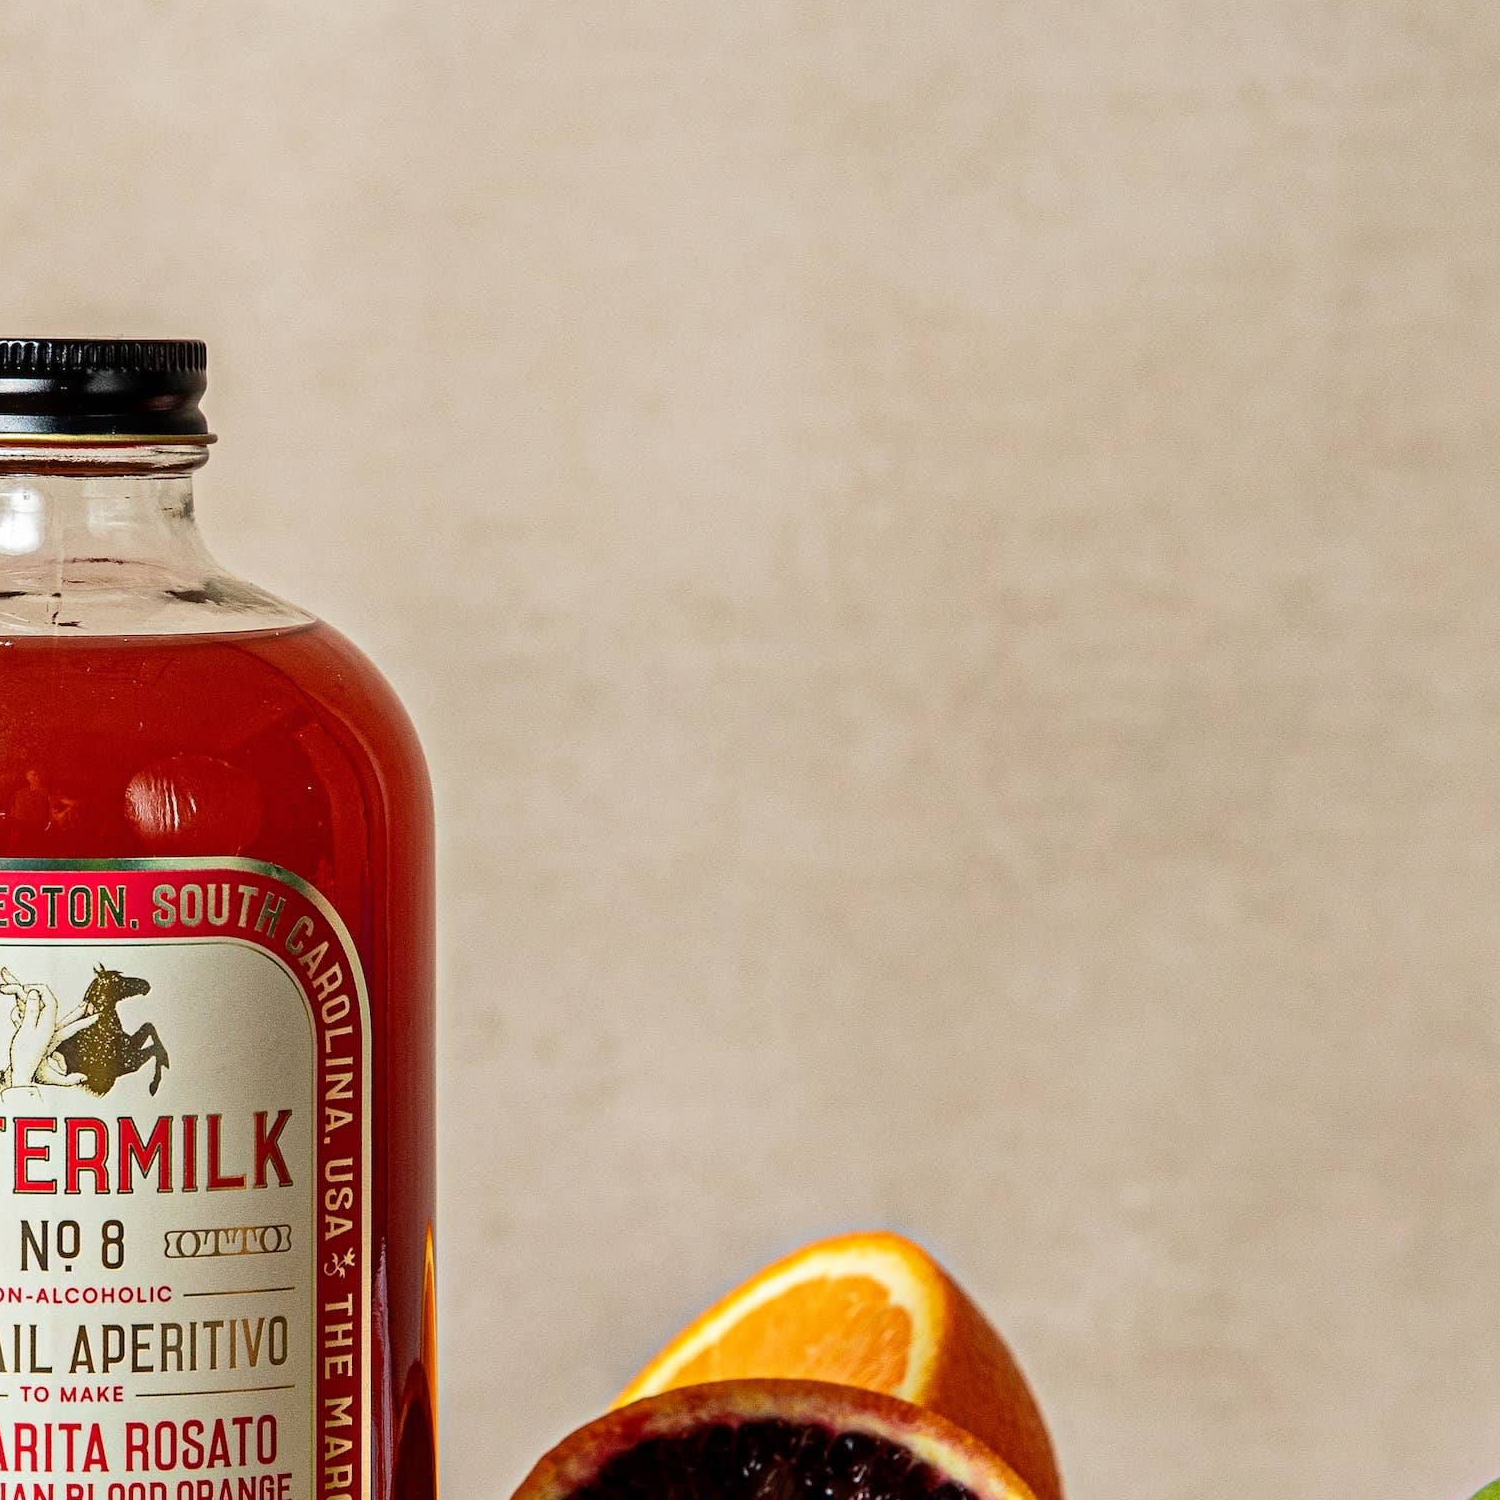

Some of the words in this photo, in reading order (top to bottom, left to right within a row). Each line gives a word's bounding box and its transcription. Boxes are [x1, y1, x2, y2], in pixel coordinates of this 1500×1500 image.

[152, 884, 286, 938] SOUTH
[324, 1156, 354, 1241] USA
[101, 1220, 124, 1269] 8
[68, 1316, 289, 1374] APERITIVO
[324, 1293, 355, 1381] THE
[20, 1386, 48, 1402] TO
[59, 1386, 125, 1402] MAKE
[126, 1414, 278, 1472] ROSATO
